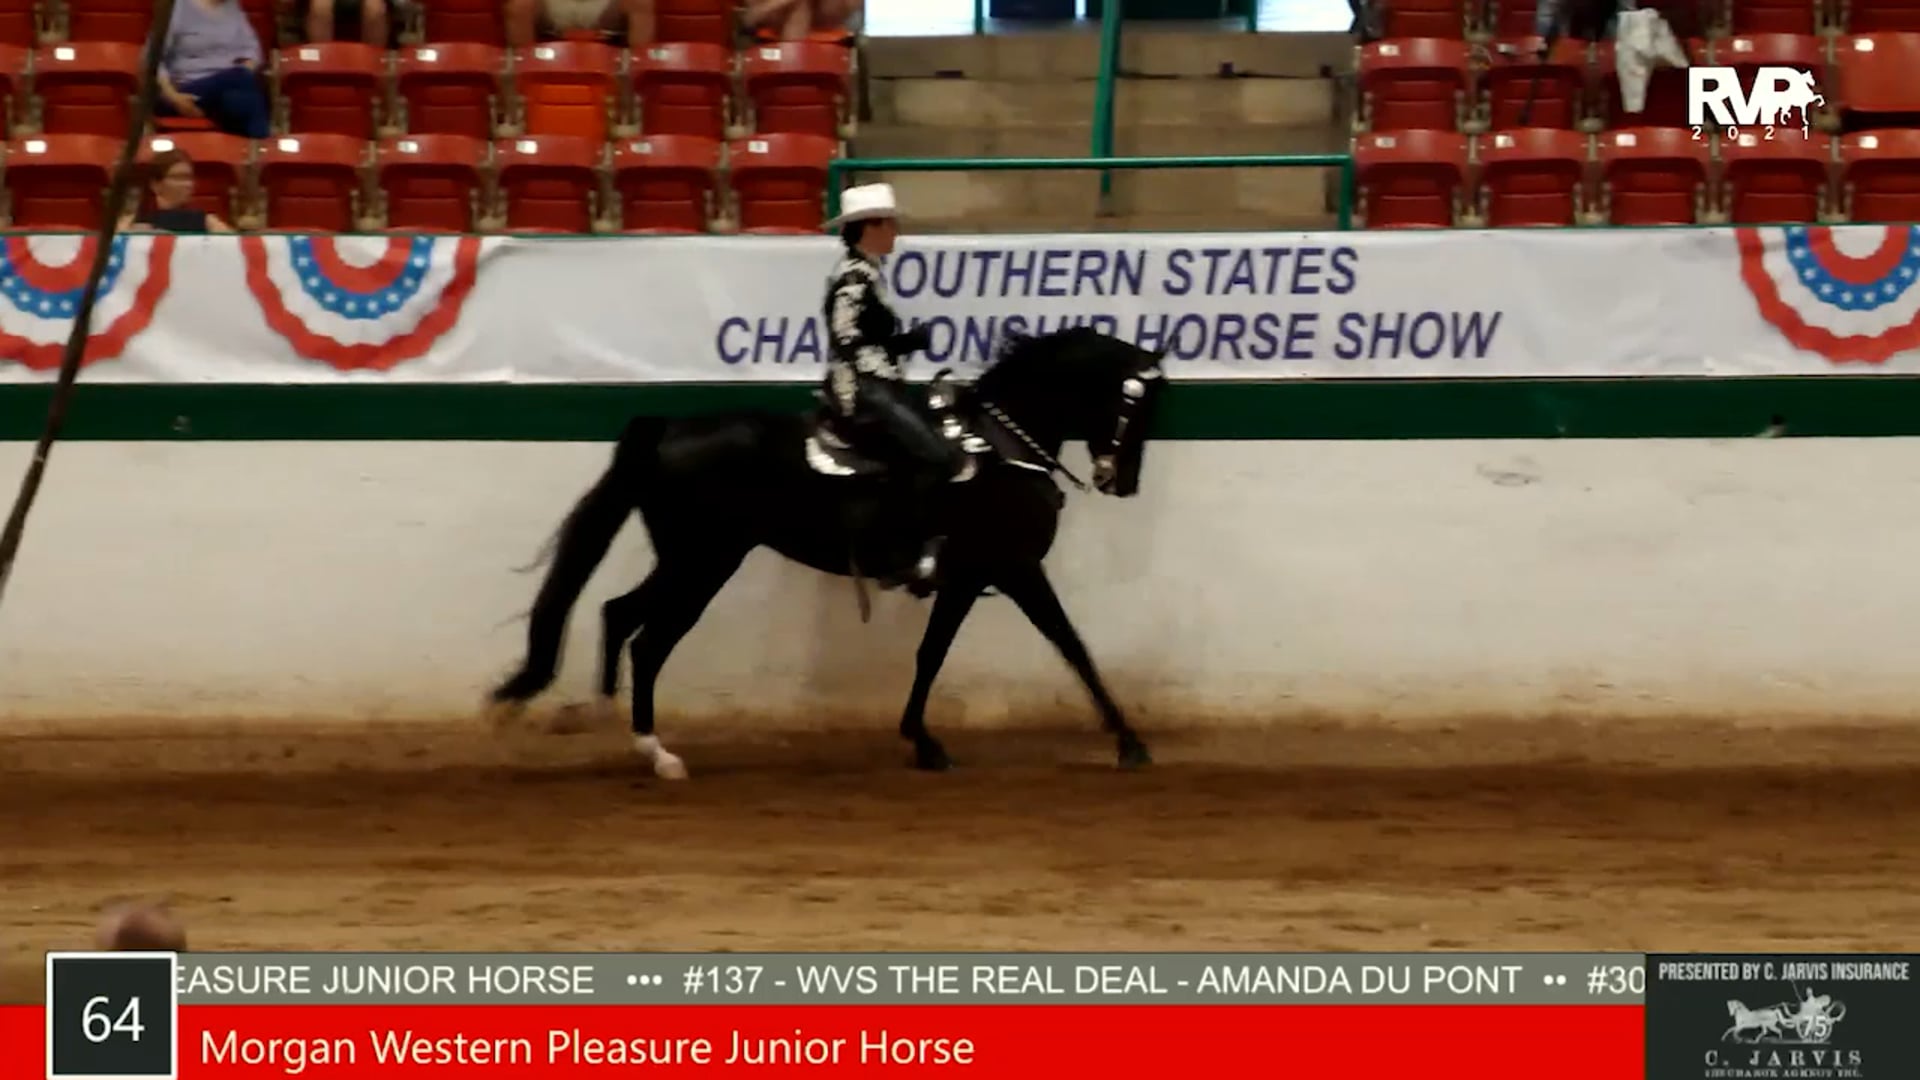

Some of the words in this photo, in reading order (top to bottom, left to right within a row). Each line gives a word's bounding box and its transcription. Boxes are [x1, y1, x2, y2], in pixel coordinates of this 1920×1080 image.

[880, 249, 1146, 298] OUTHERN
[1162, 247, 1358, 297] STATES
[716, 313, 1118, 363] CHAONSP
[1133, 312, 1319, 361] HORSE
[1334, 311, 1503, 360] SHOW
